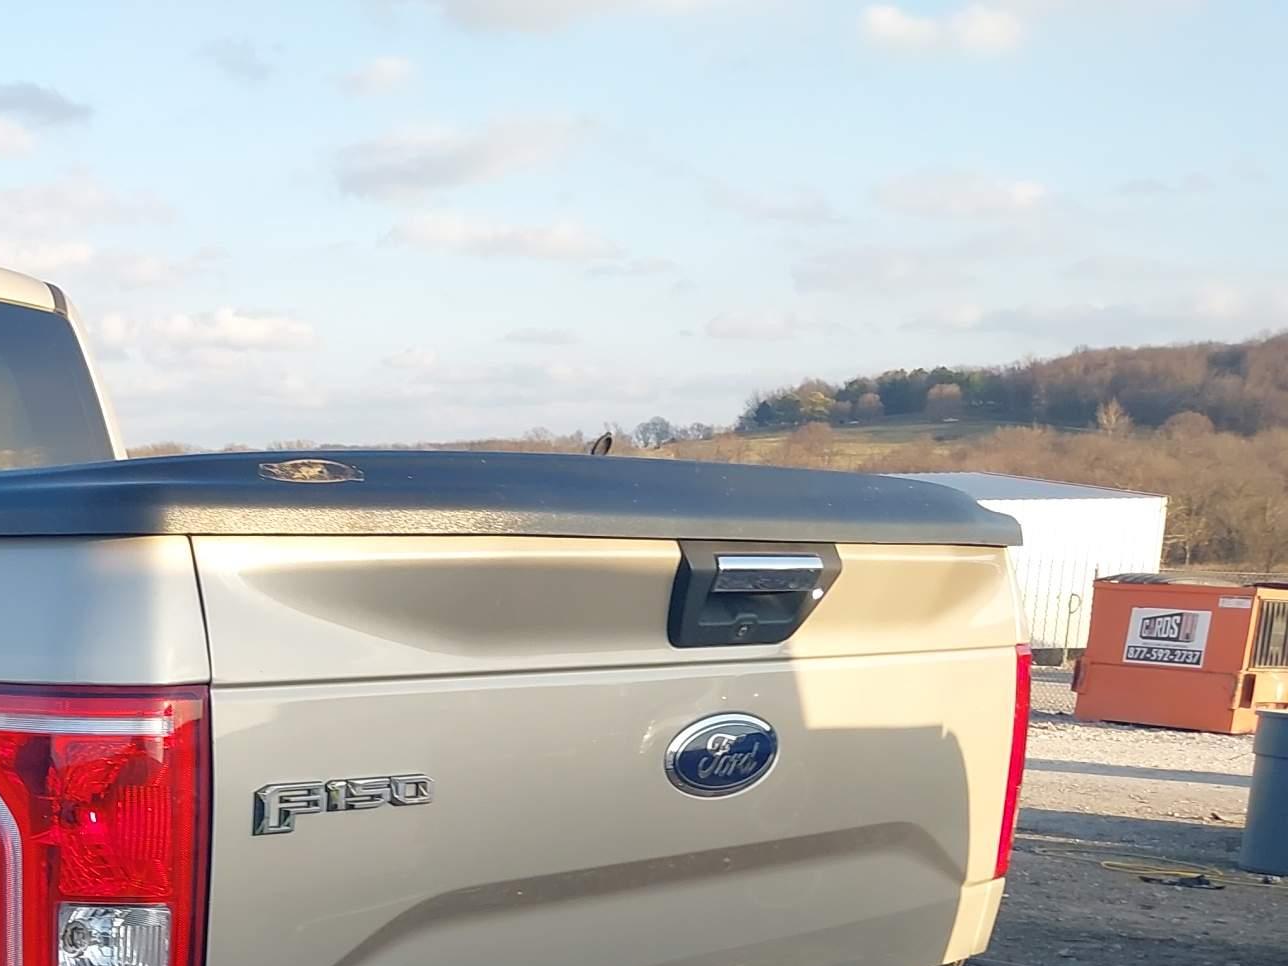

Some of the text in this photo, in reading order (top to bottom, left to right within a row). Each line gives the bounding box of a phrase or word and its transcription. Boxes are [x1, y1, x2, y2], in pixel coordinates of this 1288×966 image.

[1141, 615, 1182, 638] CARDS
[1127, 647, 1201, 664] 877-592-2737
[697, 733, 760, 779] Ford
